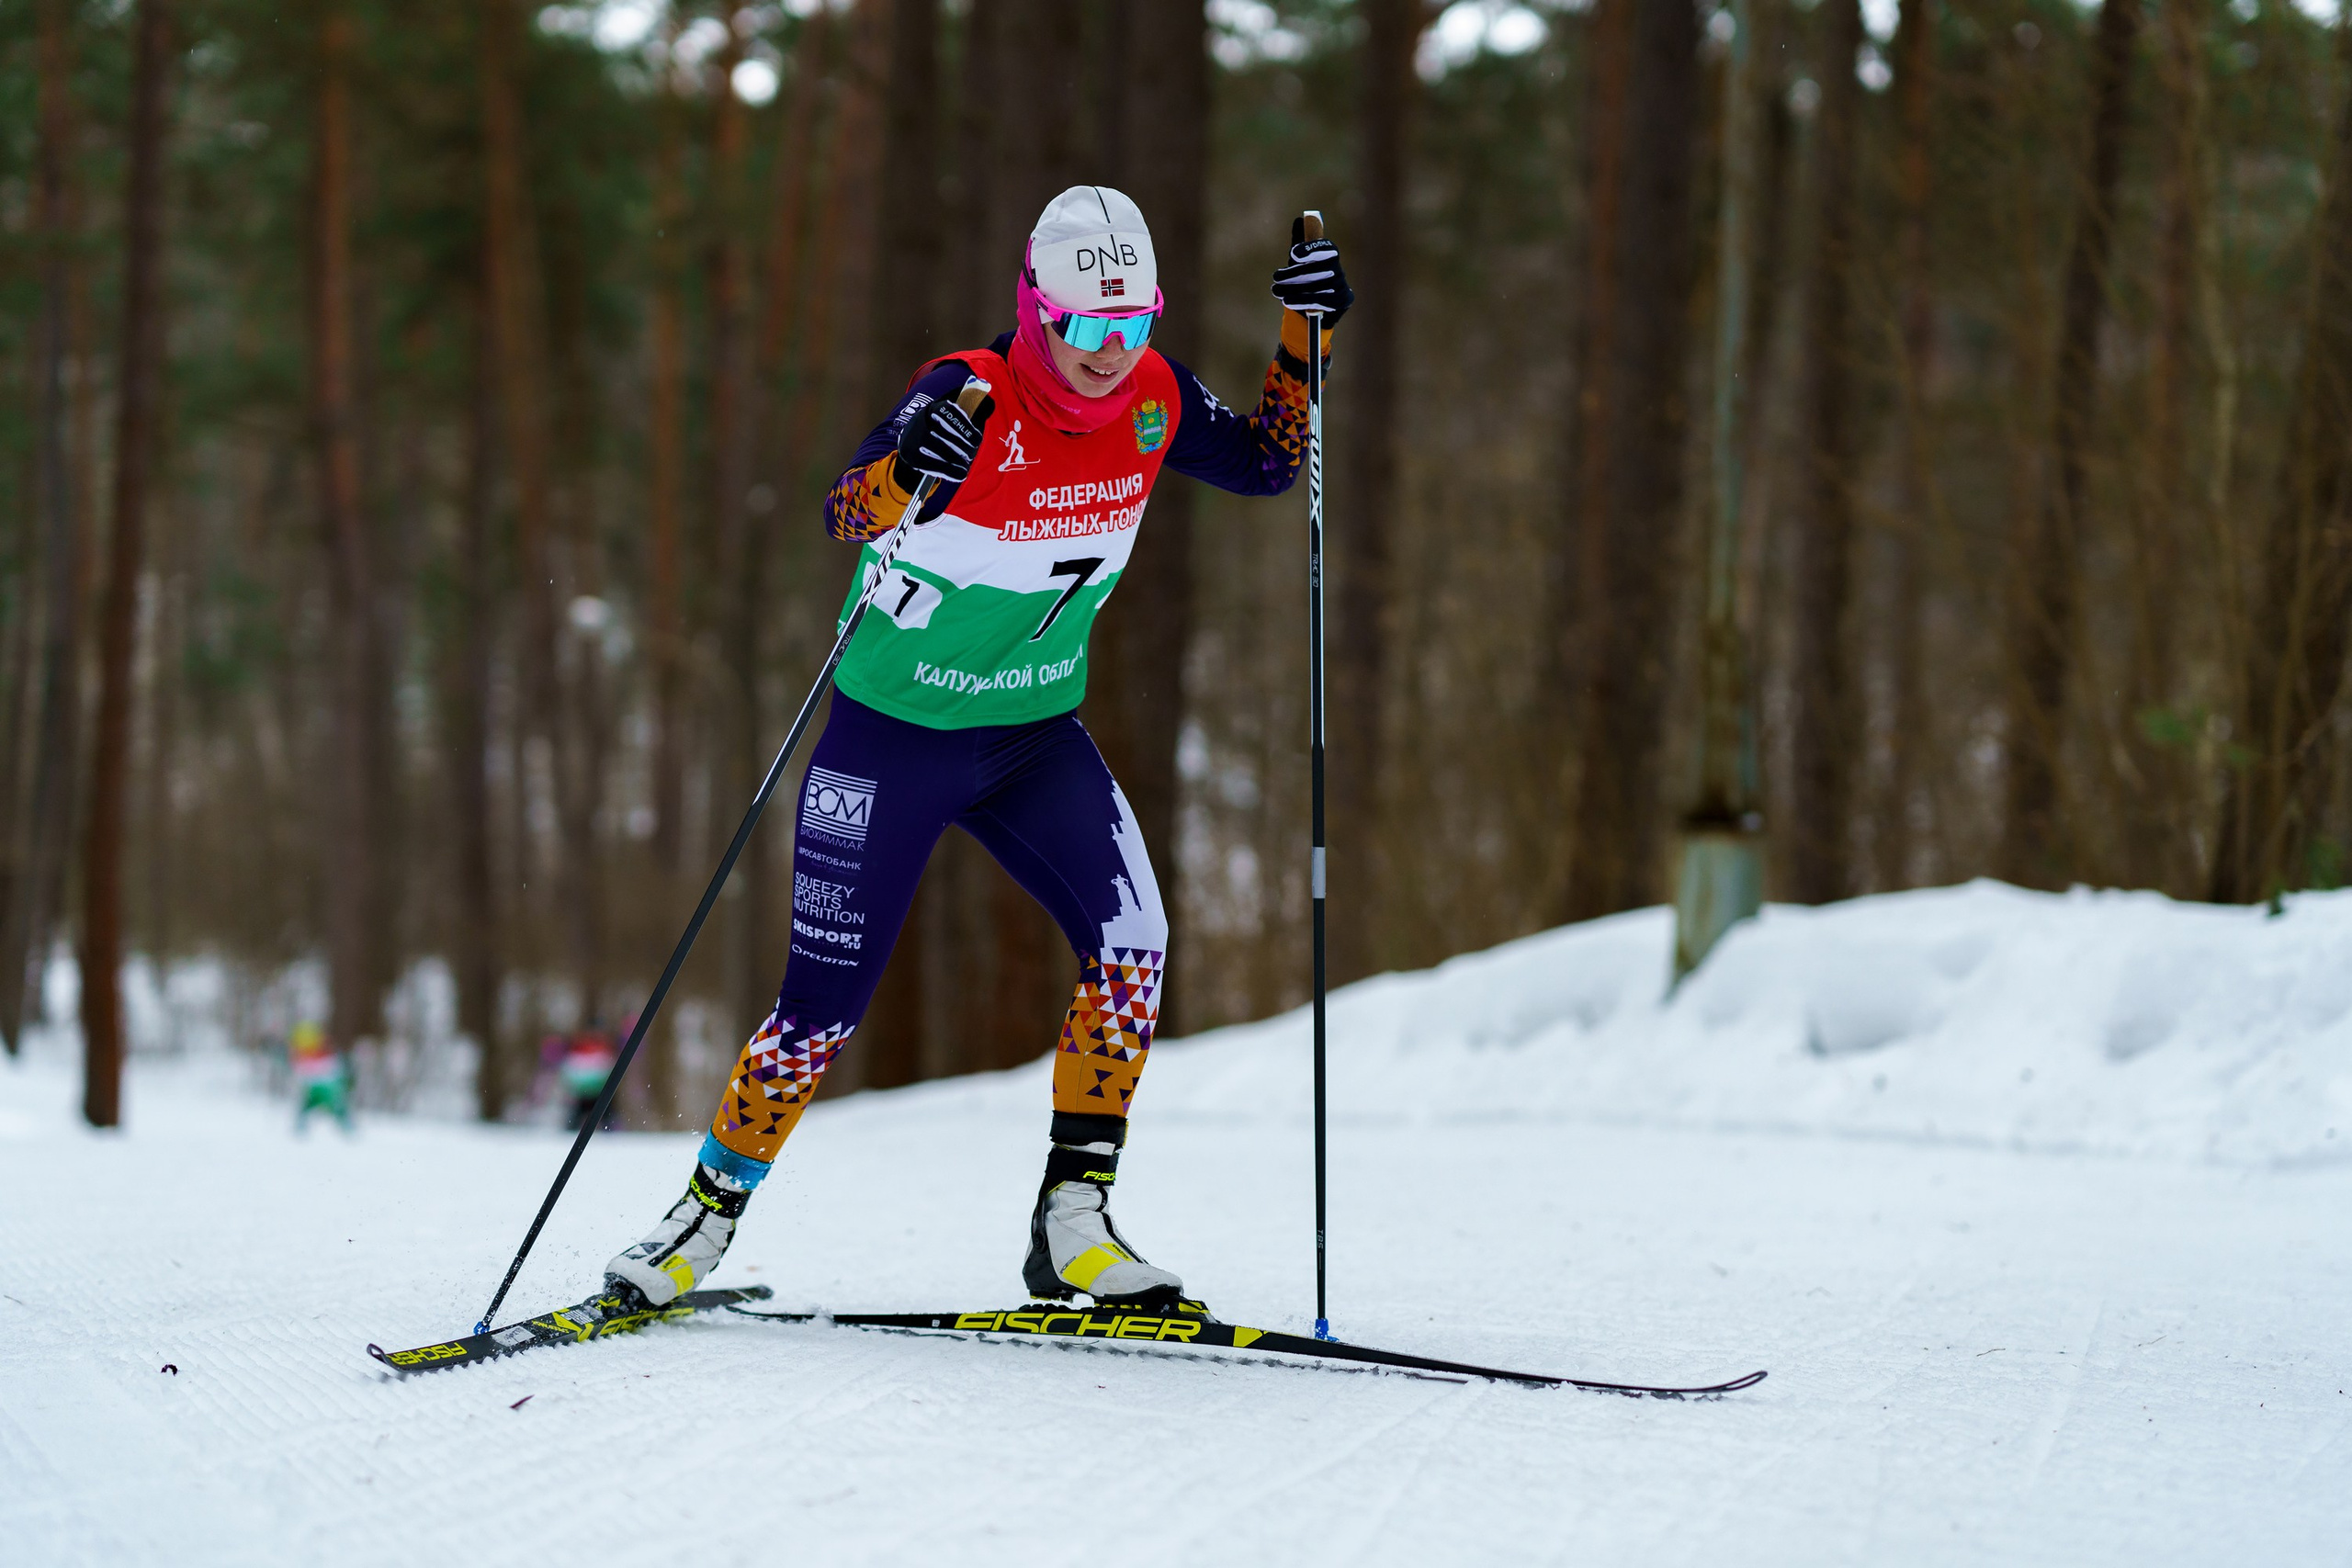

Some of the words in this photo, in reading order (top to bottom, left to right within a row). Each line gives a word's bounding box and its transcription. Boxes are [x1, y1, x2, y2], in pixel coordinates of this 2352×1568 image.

[1077, 233, 1137, 277] DNB
[1029, 472, 1143, 512] ФЕДЕРАЦИЯ
[998, 512, 1102, 541] ЛЫЖНЫХ
[1108, 494, 1148, 532] ГОНО
[893, 574, 921, 618] 7
[1029, 557, 1106, 642] 7
[794, 885, 842, 910] SPORTS
[795, 872, 855, 898] SQUEEZY
[794, 897, 865, 925] NUTRITION
[793, 919, 863, 944] SKISPORT
[954, 1313, 1202, 1343] FISCHER
[387, 1342, 468, 1365] FISCHER
